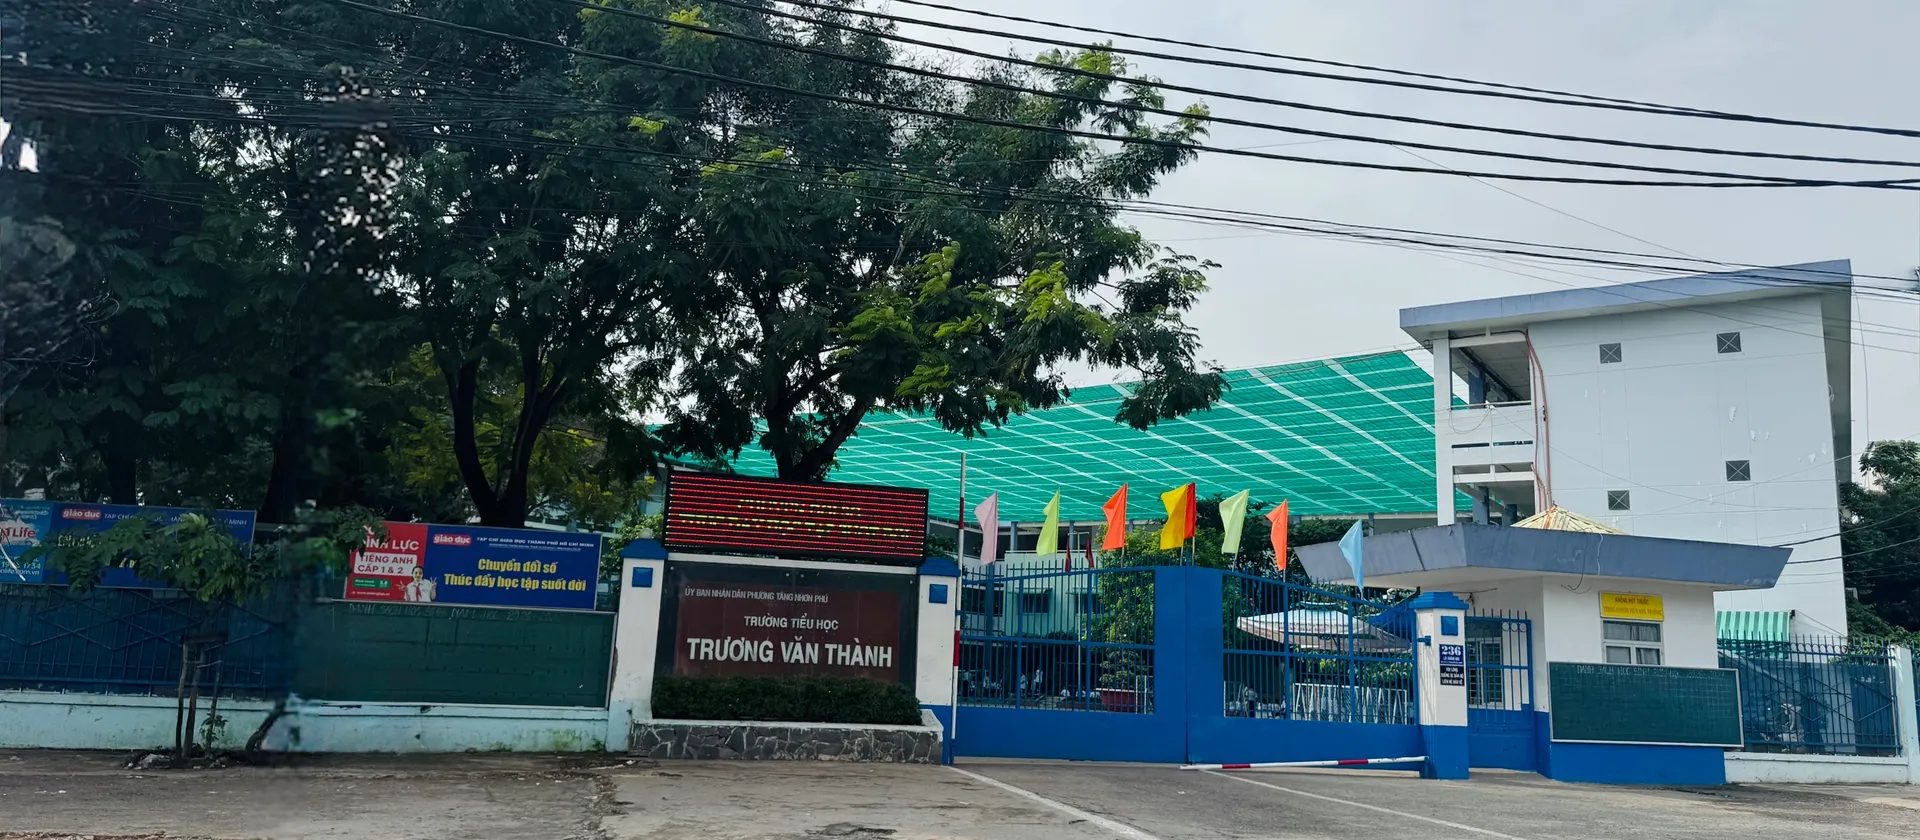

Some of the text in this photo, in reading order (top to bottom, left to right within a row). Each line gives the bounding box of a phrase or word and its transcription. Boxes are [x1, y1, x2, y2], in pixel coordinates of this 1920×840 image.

[62, 508, 101, 519] giáo dục
[392, 538, 420, 552] LỰC
[433, 533, 471, 546] giáo dục
[391, 556, 413, 565] ANH
[478, 558, 558, 574] Chuyển đổi số
[357, 563, 378, 573] CẤP
[381, 566, 385, 574] 1
[388, 566, 394, 574] &
[444, 573, 587, 592] Thúc đẩy học tập suốt đời
[696, 588, 711, 598] BAN
[712, 588, 731, 599] NHÂN
[732, 589, 746, 600] DÂN
[776, 590, 794, 602] TĂNG
[795, 591, 813, 603] NHƠN
[815, 592, 828, 604] PHÚ
[744, 612, 839, 633] TRƯỜNG TIỂU HỌC
[686, 635, 893, 668] TRƯƠNG VĂN THÀNH
[1441, 645, 1461, 656] 236
